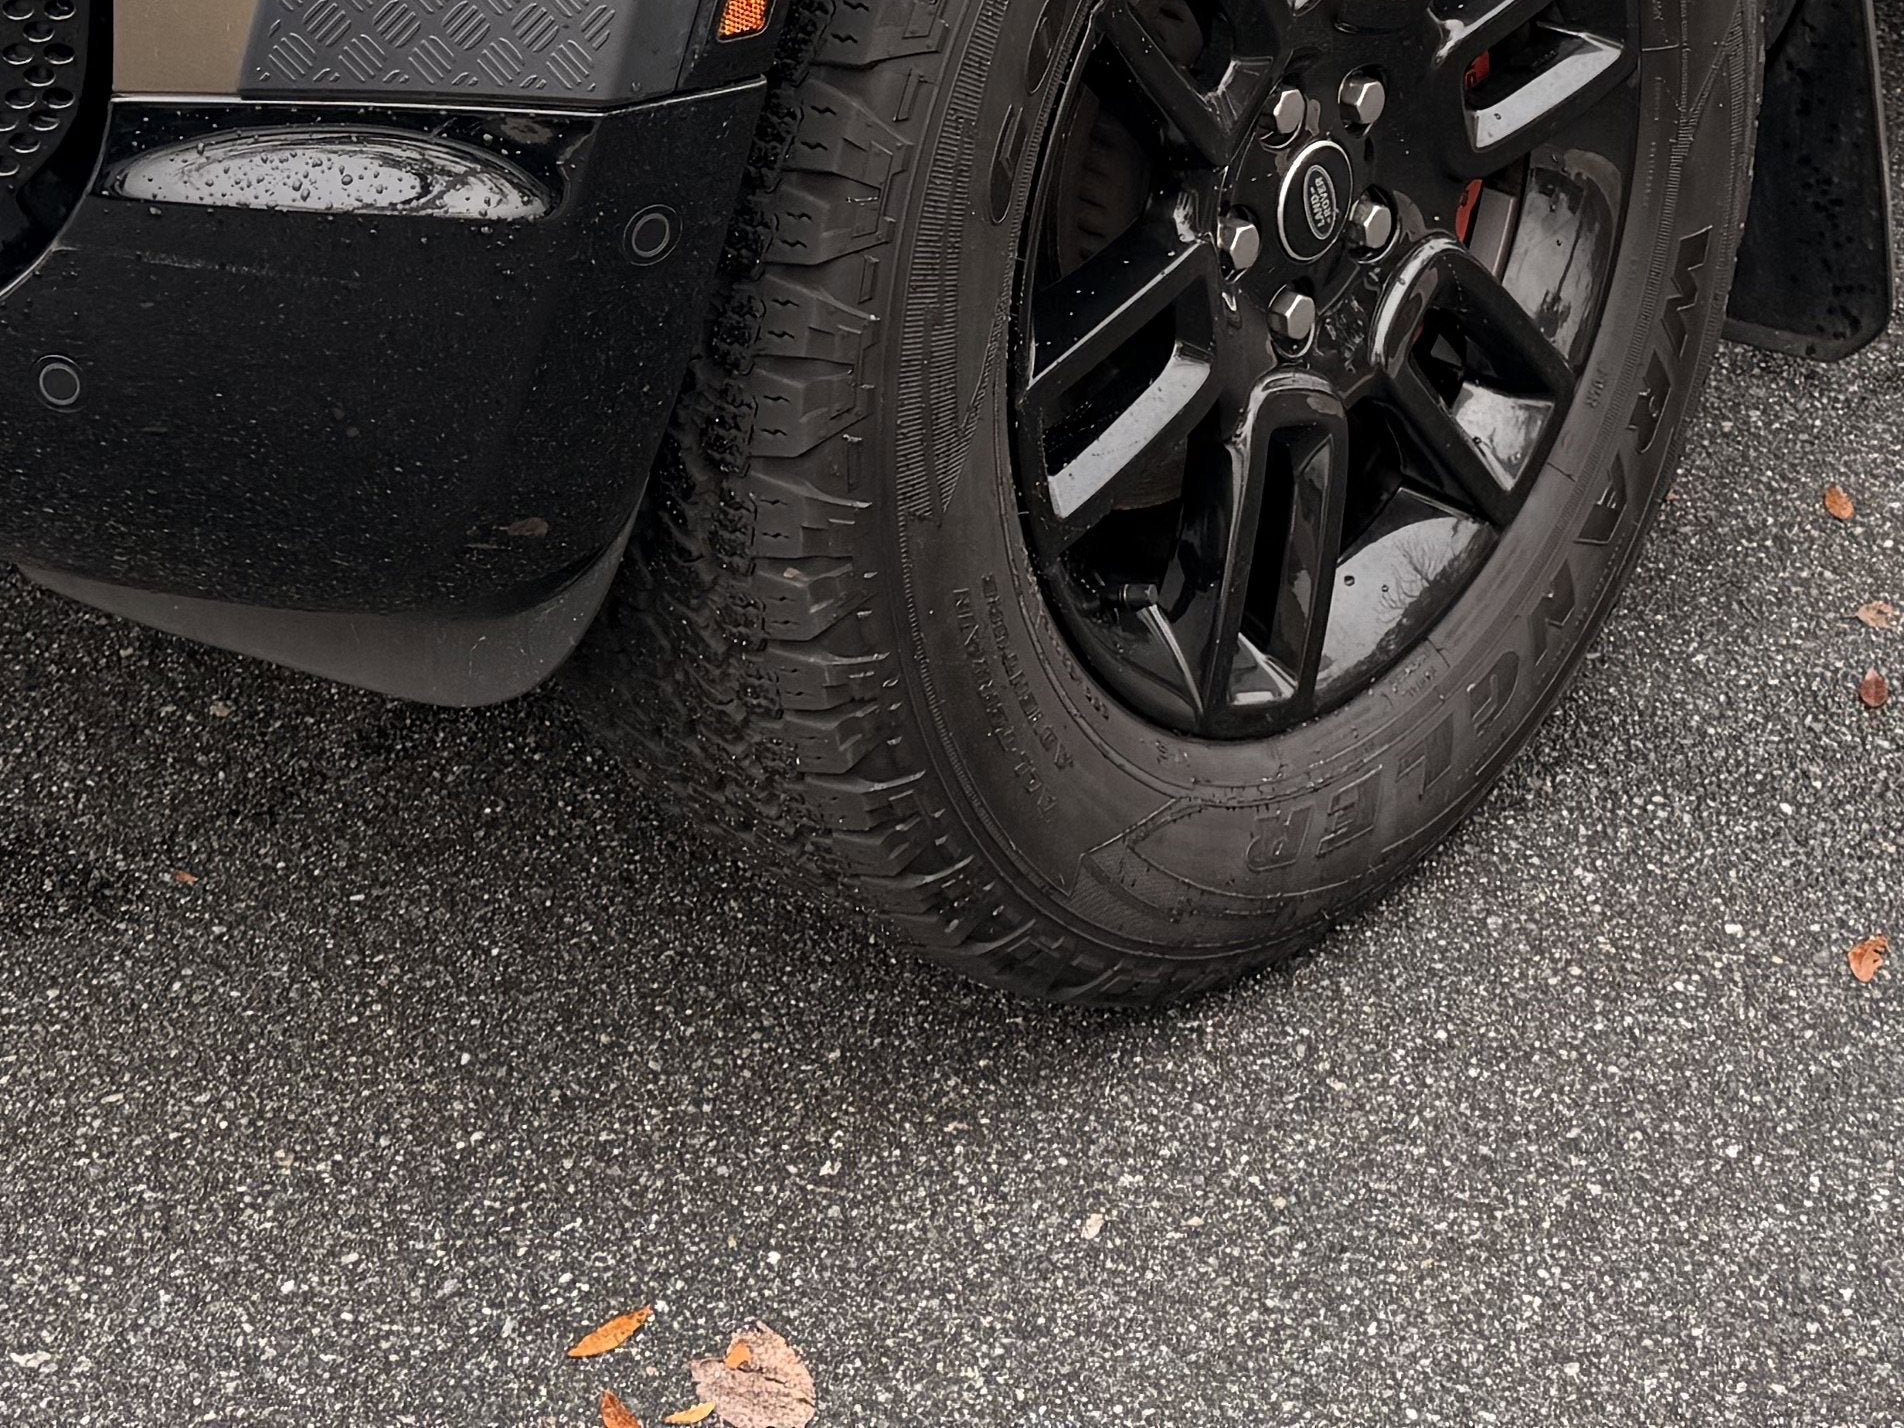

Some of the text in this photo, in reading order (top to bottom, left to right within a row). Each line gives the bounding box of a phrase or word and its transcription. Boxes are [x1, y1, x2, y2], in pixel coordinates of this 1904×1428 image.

[1310, 193, 1326, 228] LAND
[1314, 175, 1333, 219] ROVER
[1245, 224, 1714, 873] WRANGLER
